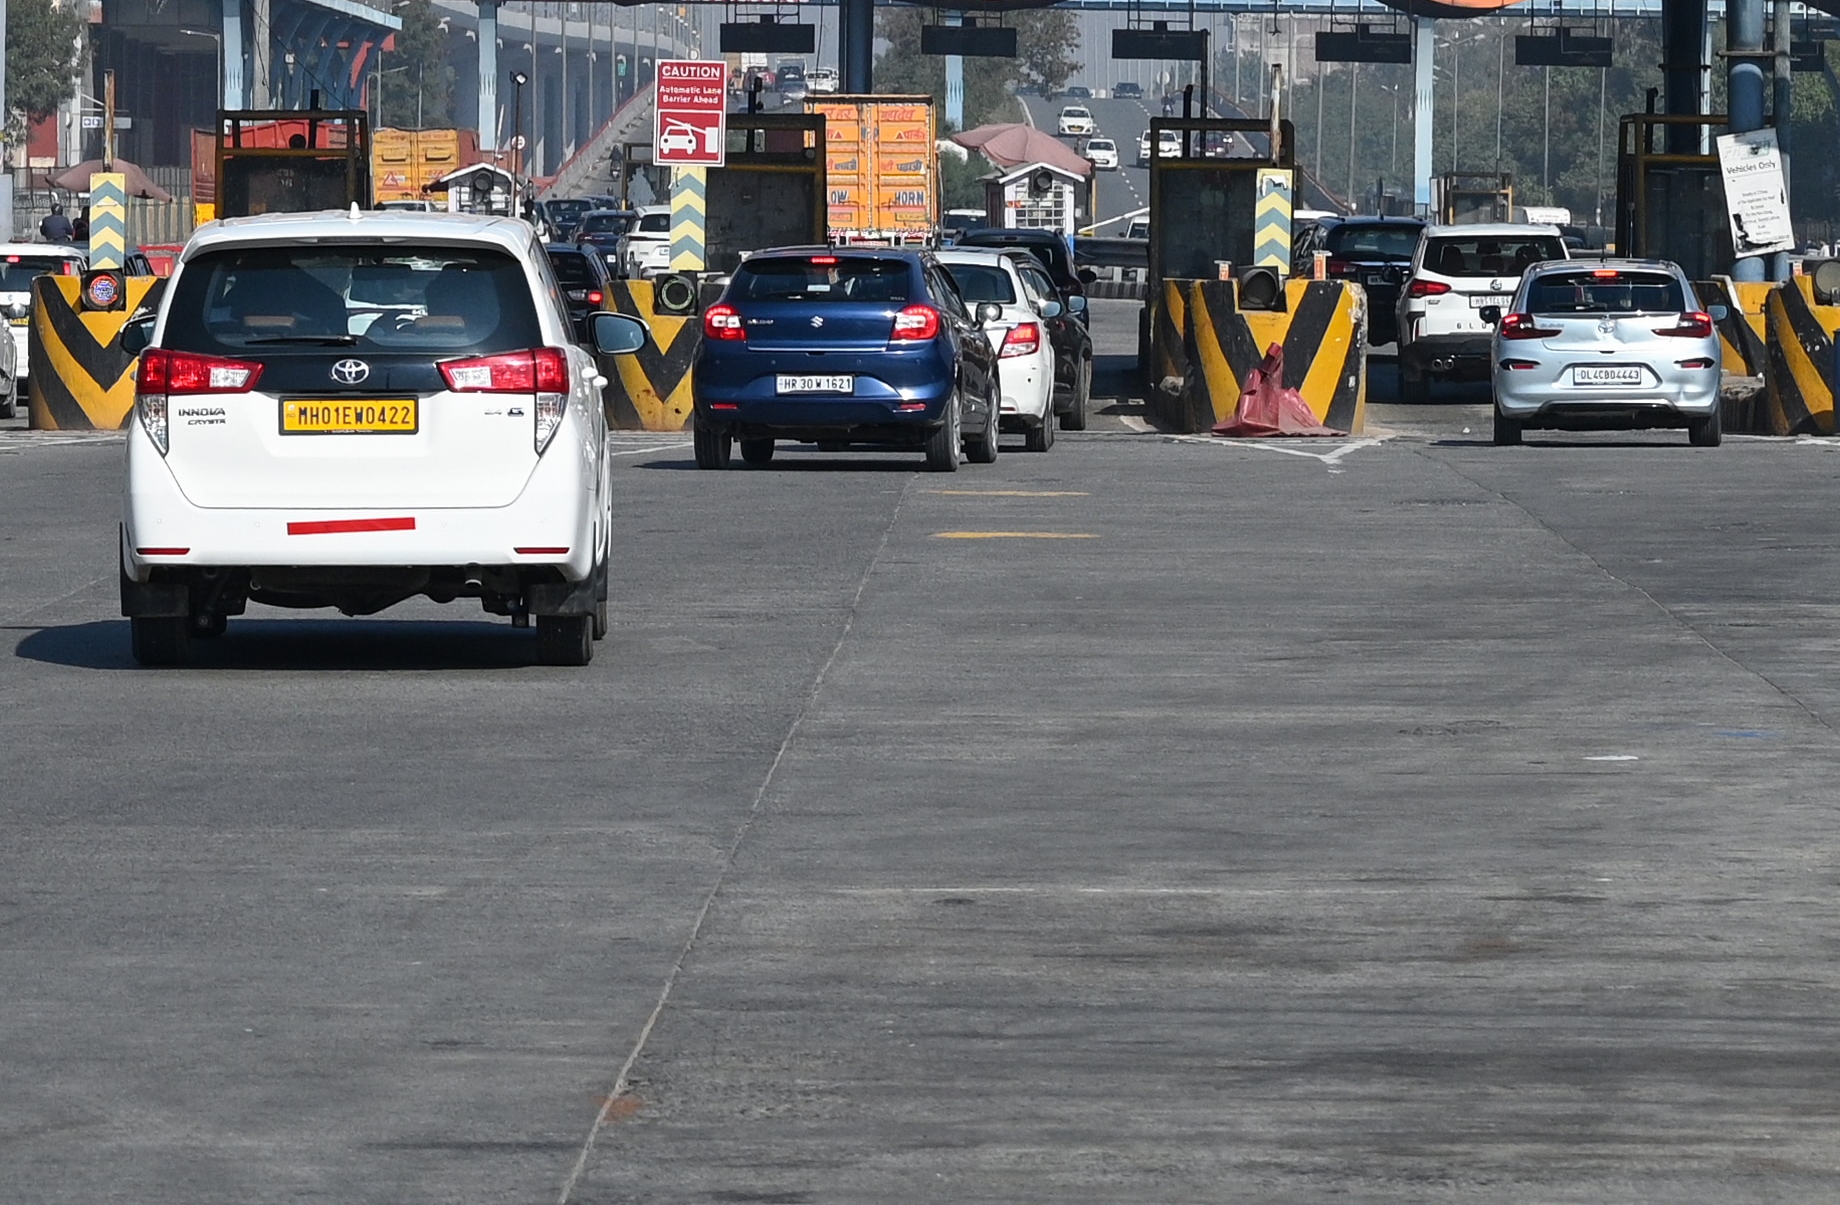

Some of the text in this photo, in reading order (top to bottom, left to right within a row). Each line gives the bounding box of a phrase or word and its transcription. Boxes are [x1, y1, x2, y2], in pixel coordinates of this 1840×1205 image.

[661, 65, 720, 77] CAUTION
[659, 85, 722, 94] Automatic Lane
[663, 95, 719, 104] Barrier Ahead
[895, 190, 924, 206] HORN
[784, 378, 851, 389] HR 30 W 1621
[178, 407, 226, 417] INNOVA
[297, 406, 410, 425] MH01EW0422
[187, 418, 226, 426] CRYSTA
